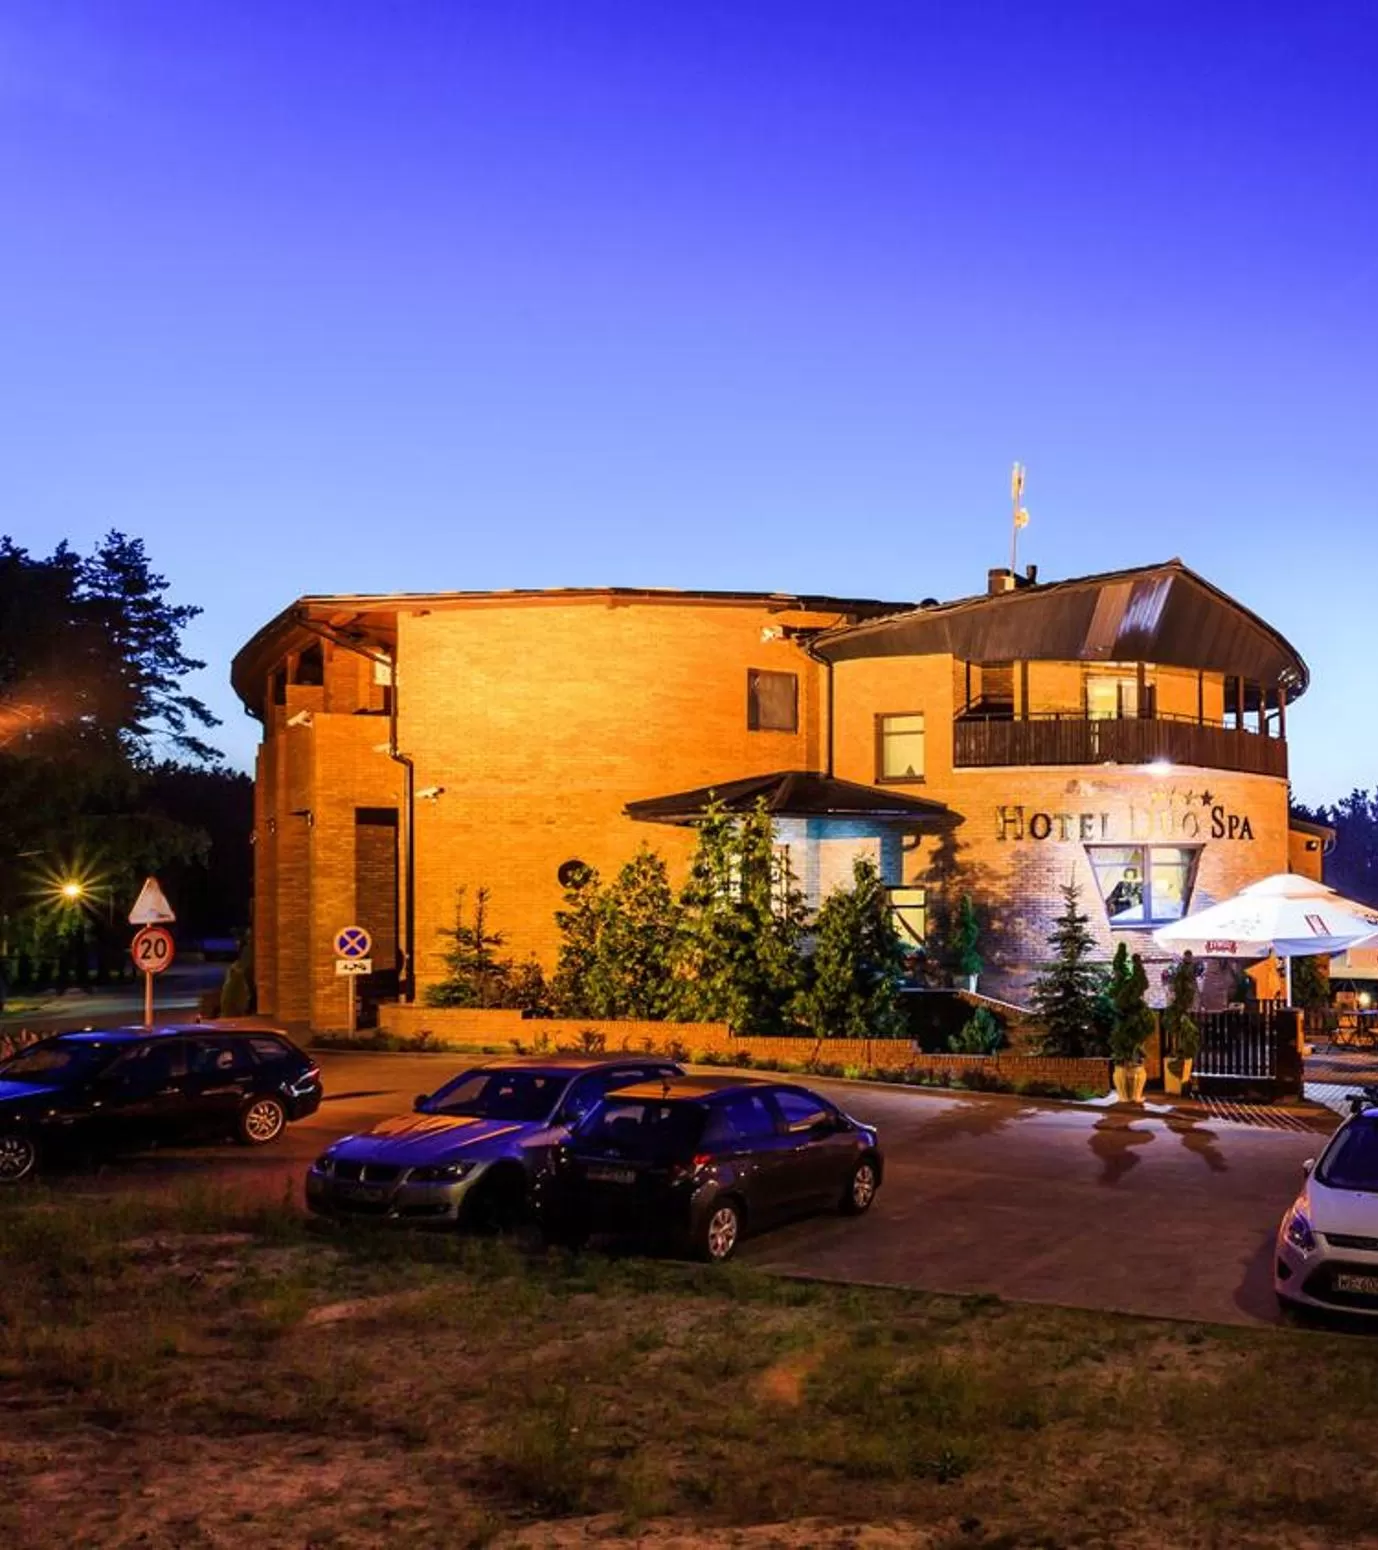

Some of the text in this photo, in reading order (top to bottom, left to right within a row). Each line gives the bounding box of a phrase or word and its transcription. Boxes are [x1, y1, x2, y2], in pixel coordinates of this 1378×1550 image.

[996, 805, 1115, 841] HOTEL
[1211, 805, 1254, 840] SPA
[141, 938, 167, 959] 20
